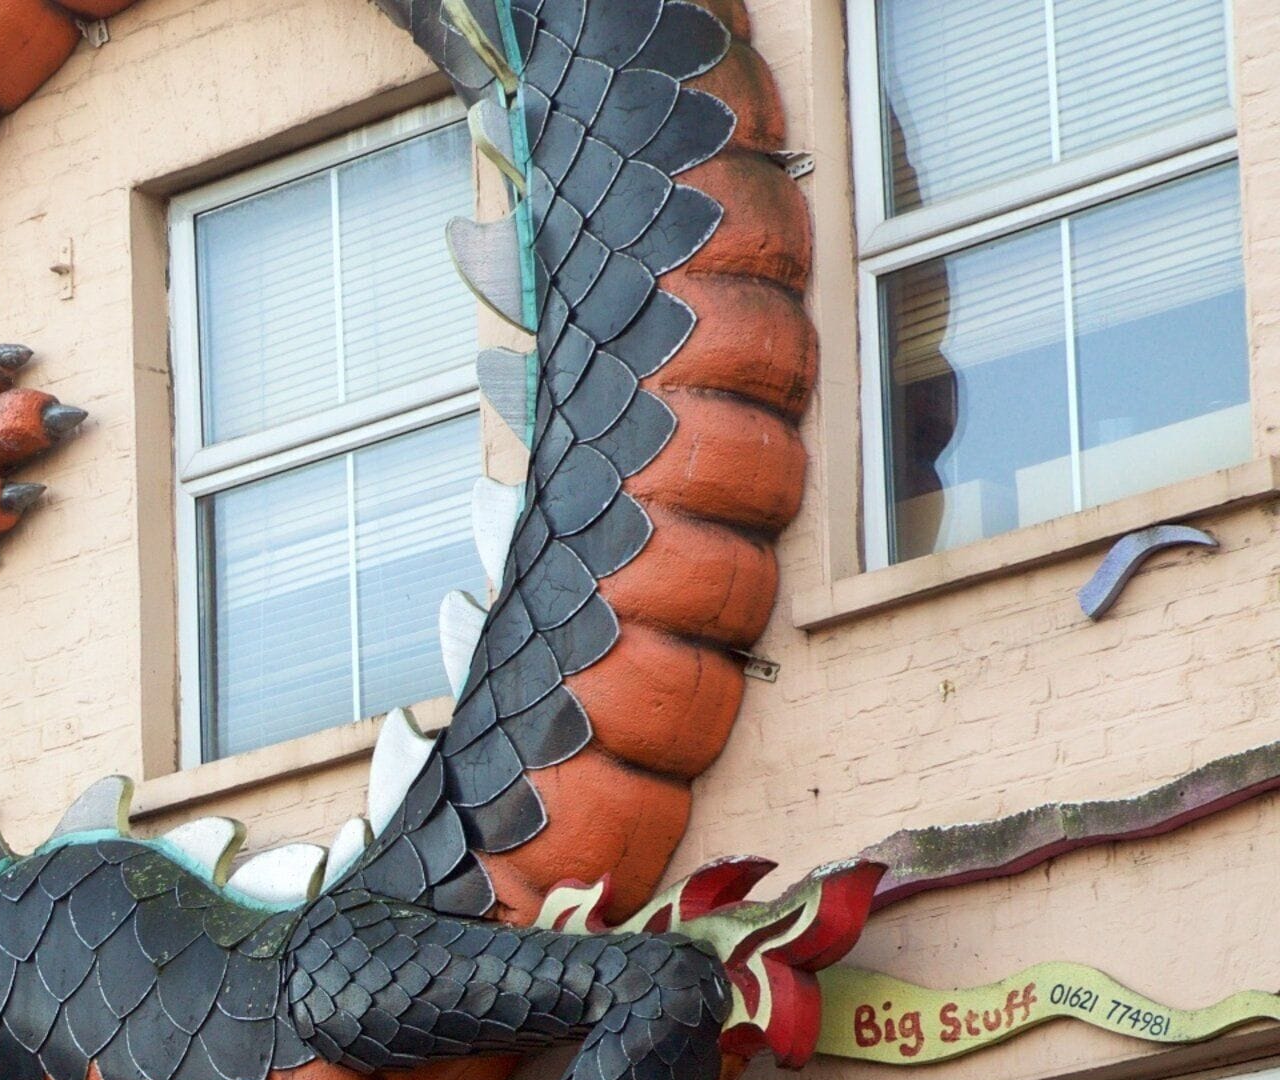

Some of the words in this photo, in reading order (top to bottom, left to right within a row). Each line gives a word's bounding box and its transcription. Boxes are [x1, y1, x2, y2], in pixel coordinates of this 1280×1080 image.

[853, 1001, 924, 1057] Big
[939, 982, 1038, 1043] Stuff
[1049, 983, 1099, 1014] 01621
[1106, 999, 1171, 1037] 774981
